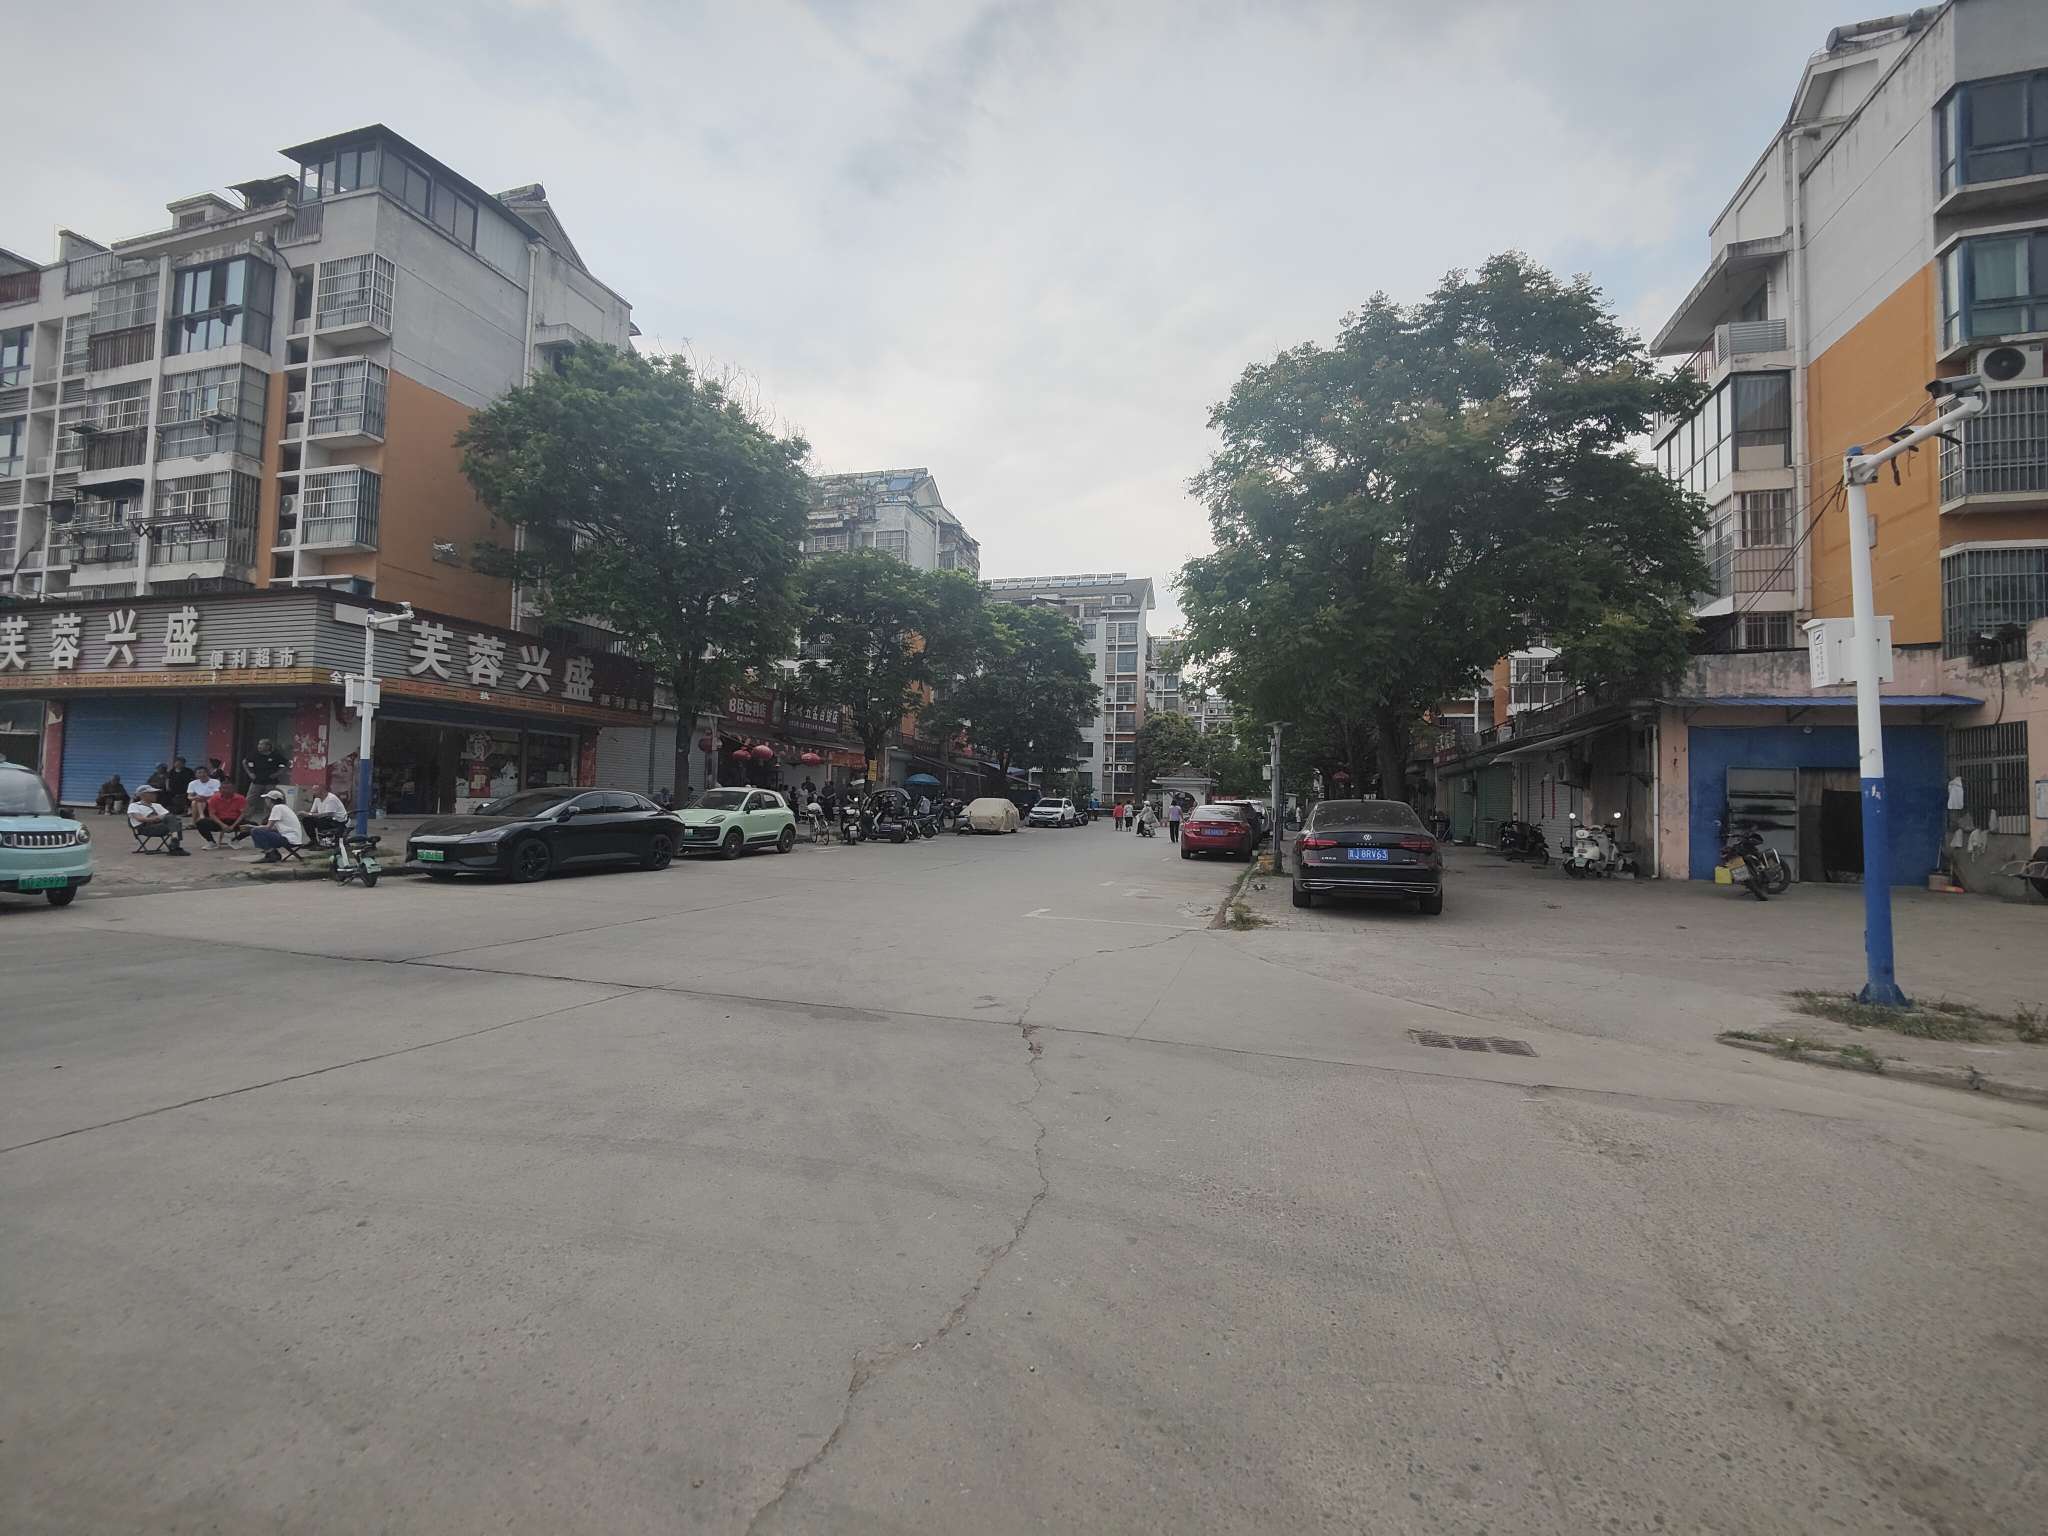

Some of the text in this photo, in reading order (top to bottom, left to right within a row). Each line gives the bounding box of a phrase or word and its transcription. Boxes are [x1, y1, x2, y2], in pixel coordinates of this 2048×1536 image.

[0, 606, 200, 670] 芙蓉兴盛
[209, 647, 295, 670] 便利超市
[408, 620, 594, 702] 芙蓉兴盛
